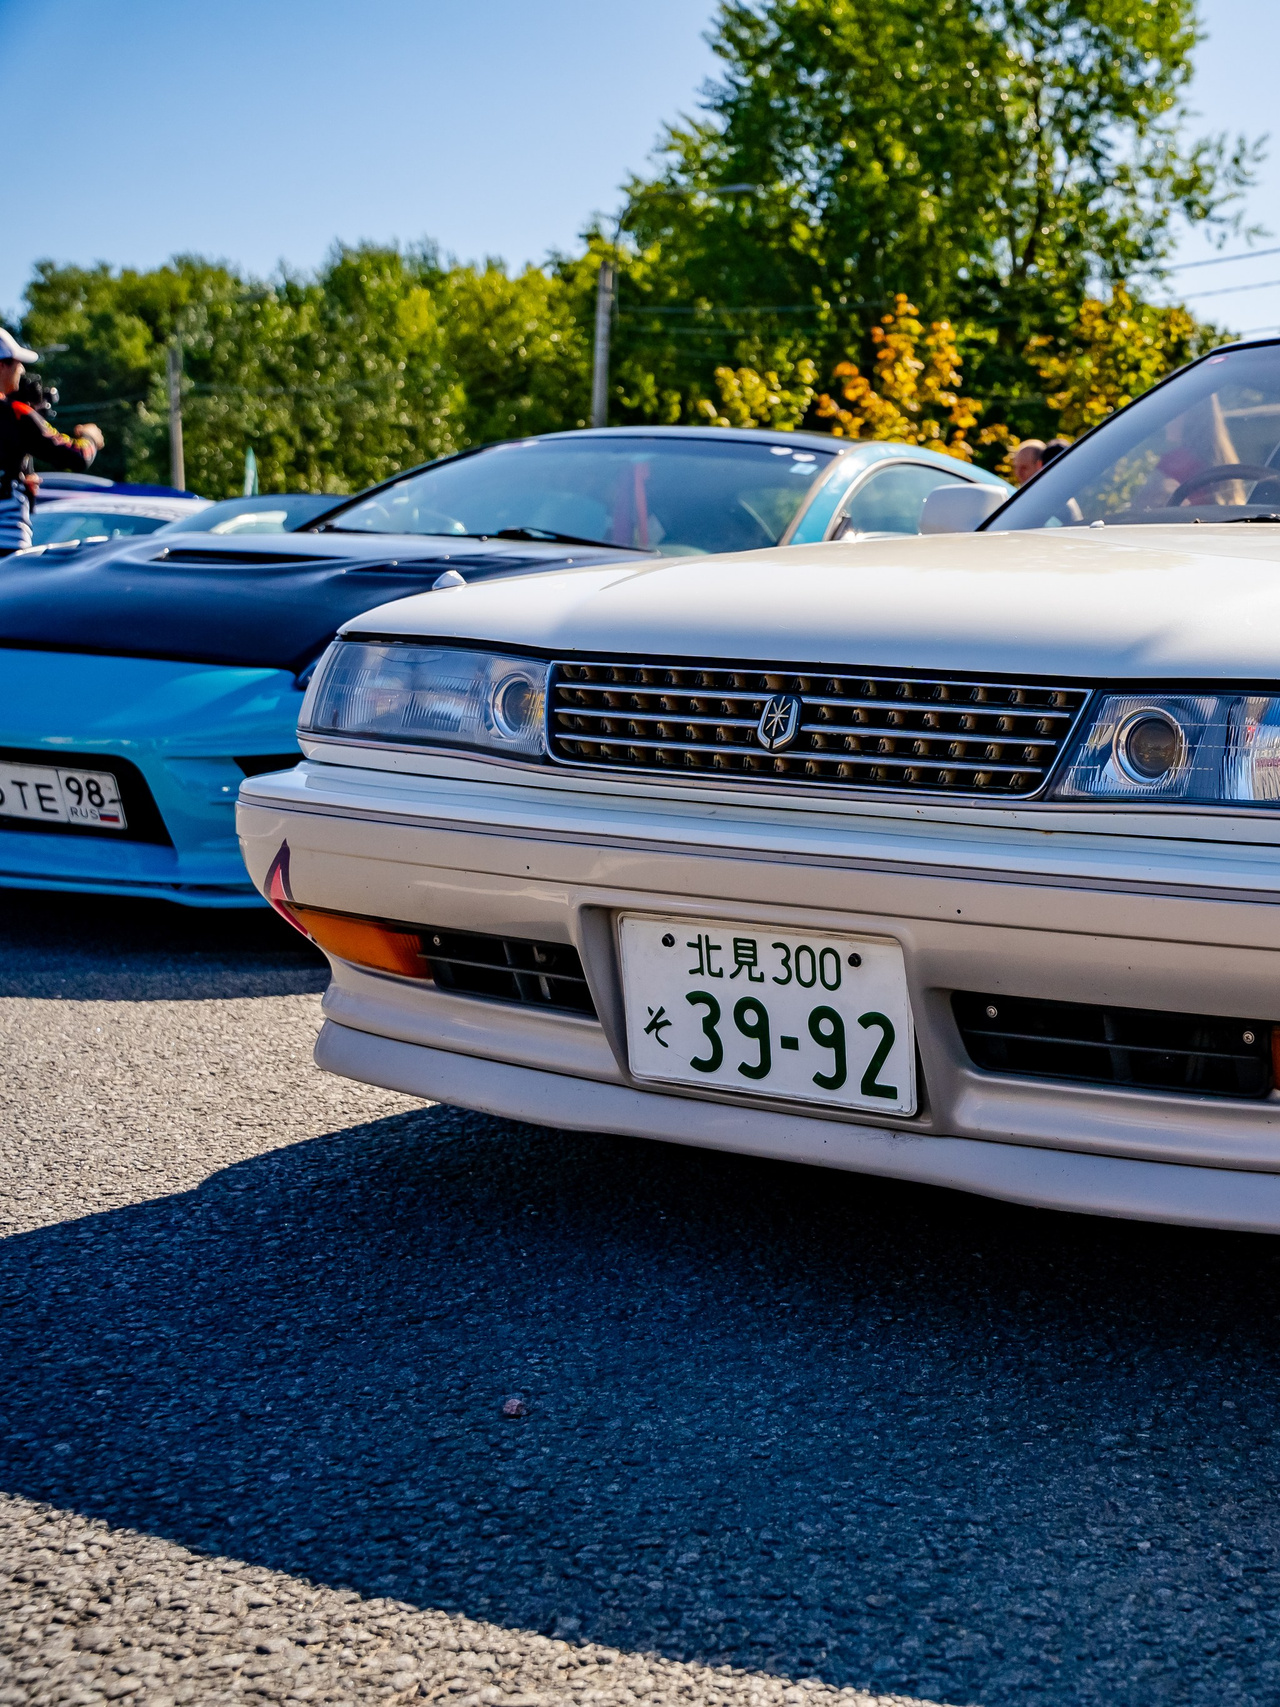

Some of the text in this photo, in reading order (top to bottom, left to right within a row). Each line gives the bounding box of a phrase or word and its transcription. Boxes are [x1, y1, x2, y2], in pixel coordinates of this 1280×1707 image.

[65, 776, 105, 808] 98
[70, 806, 99, 820] RUS
[643, 990, 898, 1100] そ 39-92
